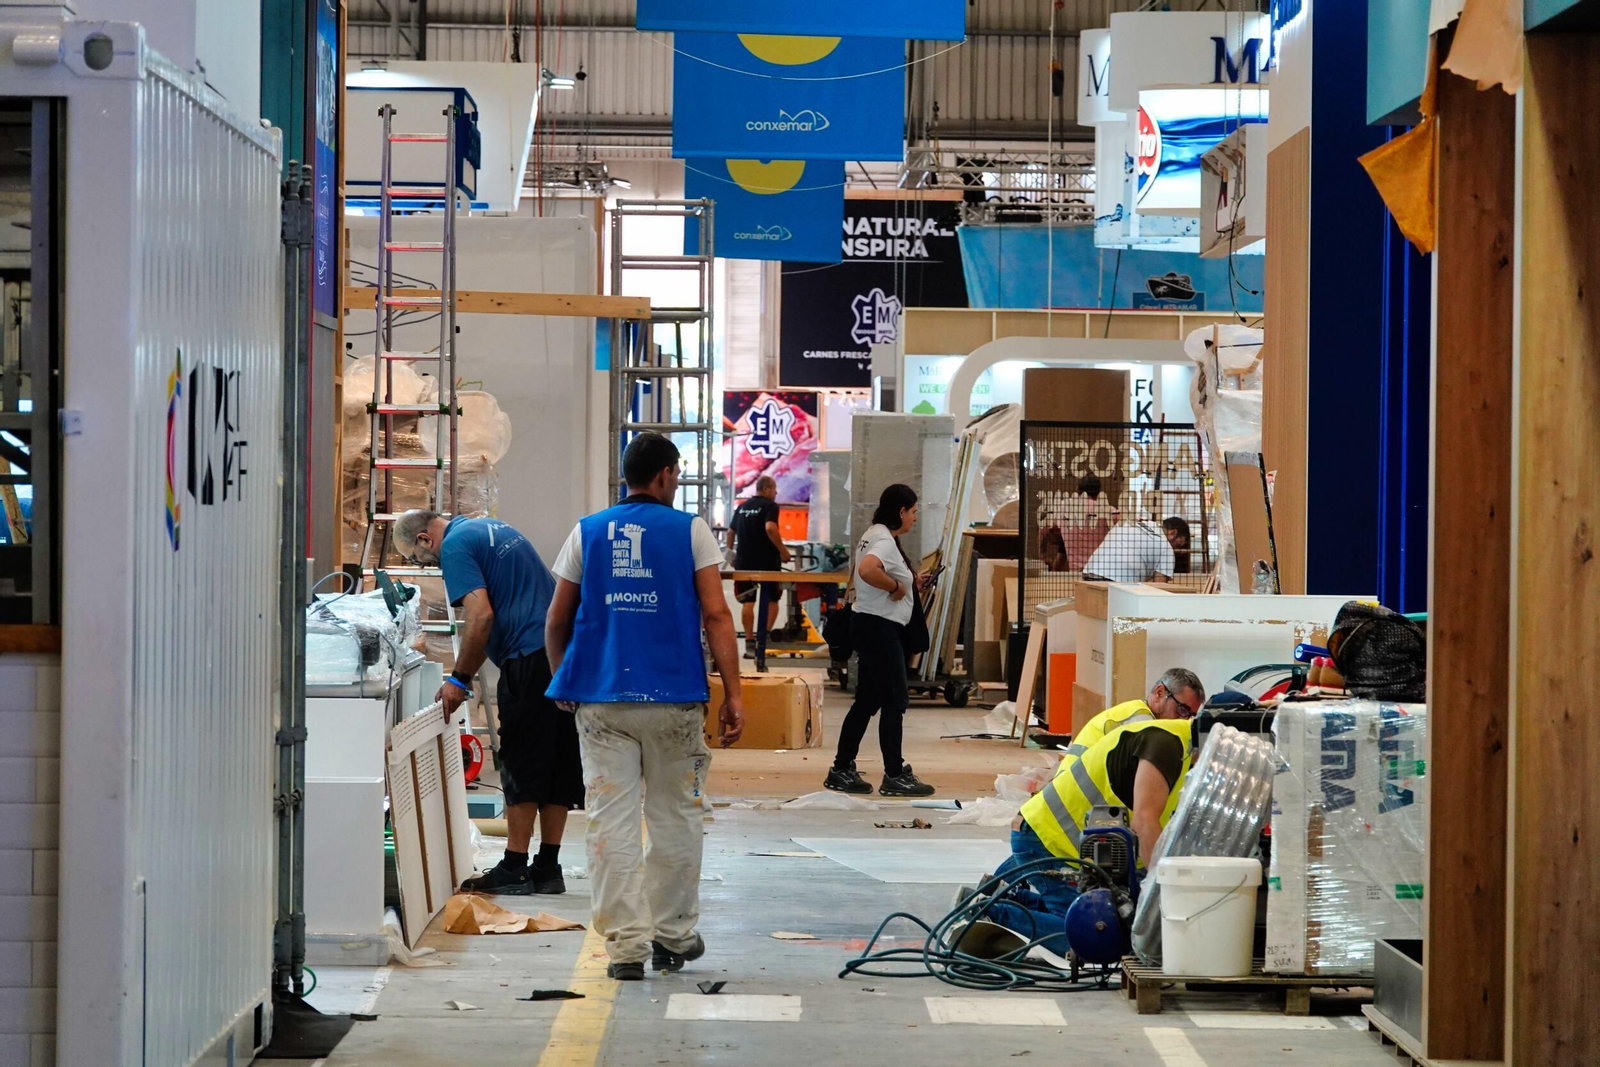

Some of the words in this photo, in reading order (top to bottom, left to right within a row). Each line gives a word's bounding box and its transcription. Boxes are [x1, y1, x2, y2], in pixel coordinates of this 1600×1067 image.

[1211, 36, 1270, 84] M
[745, 121, 813, 131] conxemar
[733, 232, 780, 240] conxemar
[803, 351, 839, 359] CARNES
[613, 540, 630, 549] NADIE
[613, 549, 629, 558] PINTA
[613, 559, 629, 567] COMO
[632, 559, 641, 568] UN
[613, 568, 653, 578] PROFESIONAL
[613, 591, 658, 603] MONTÓ
